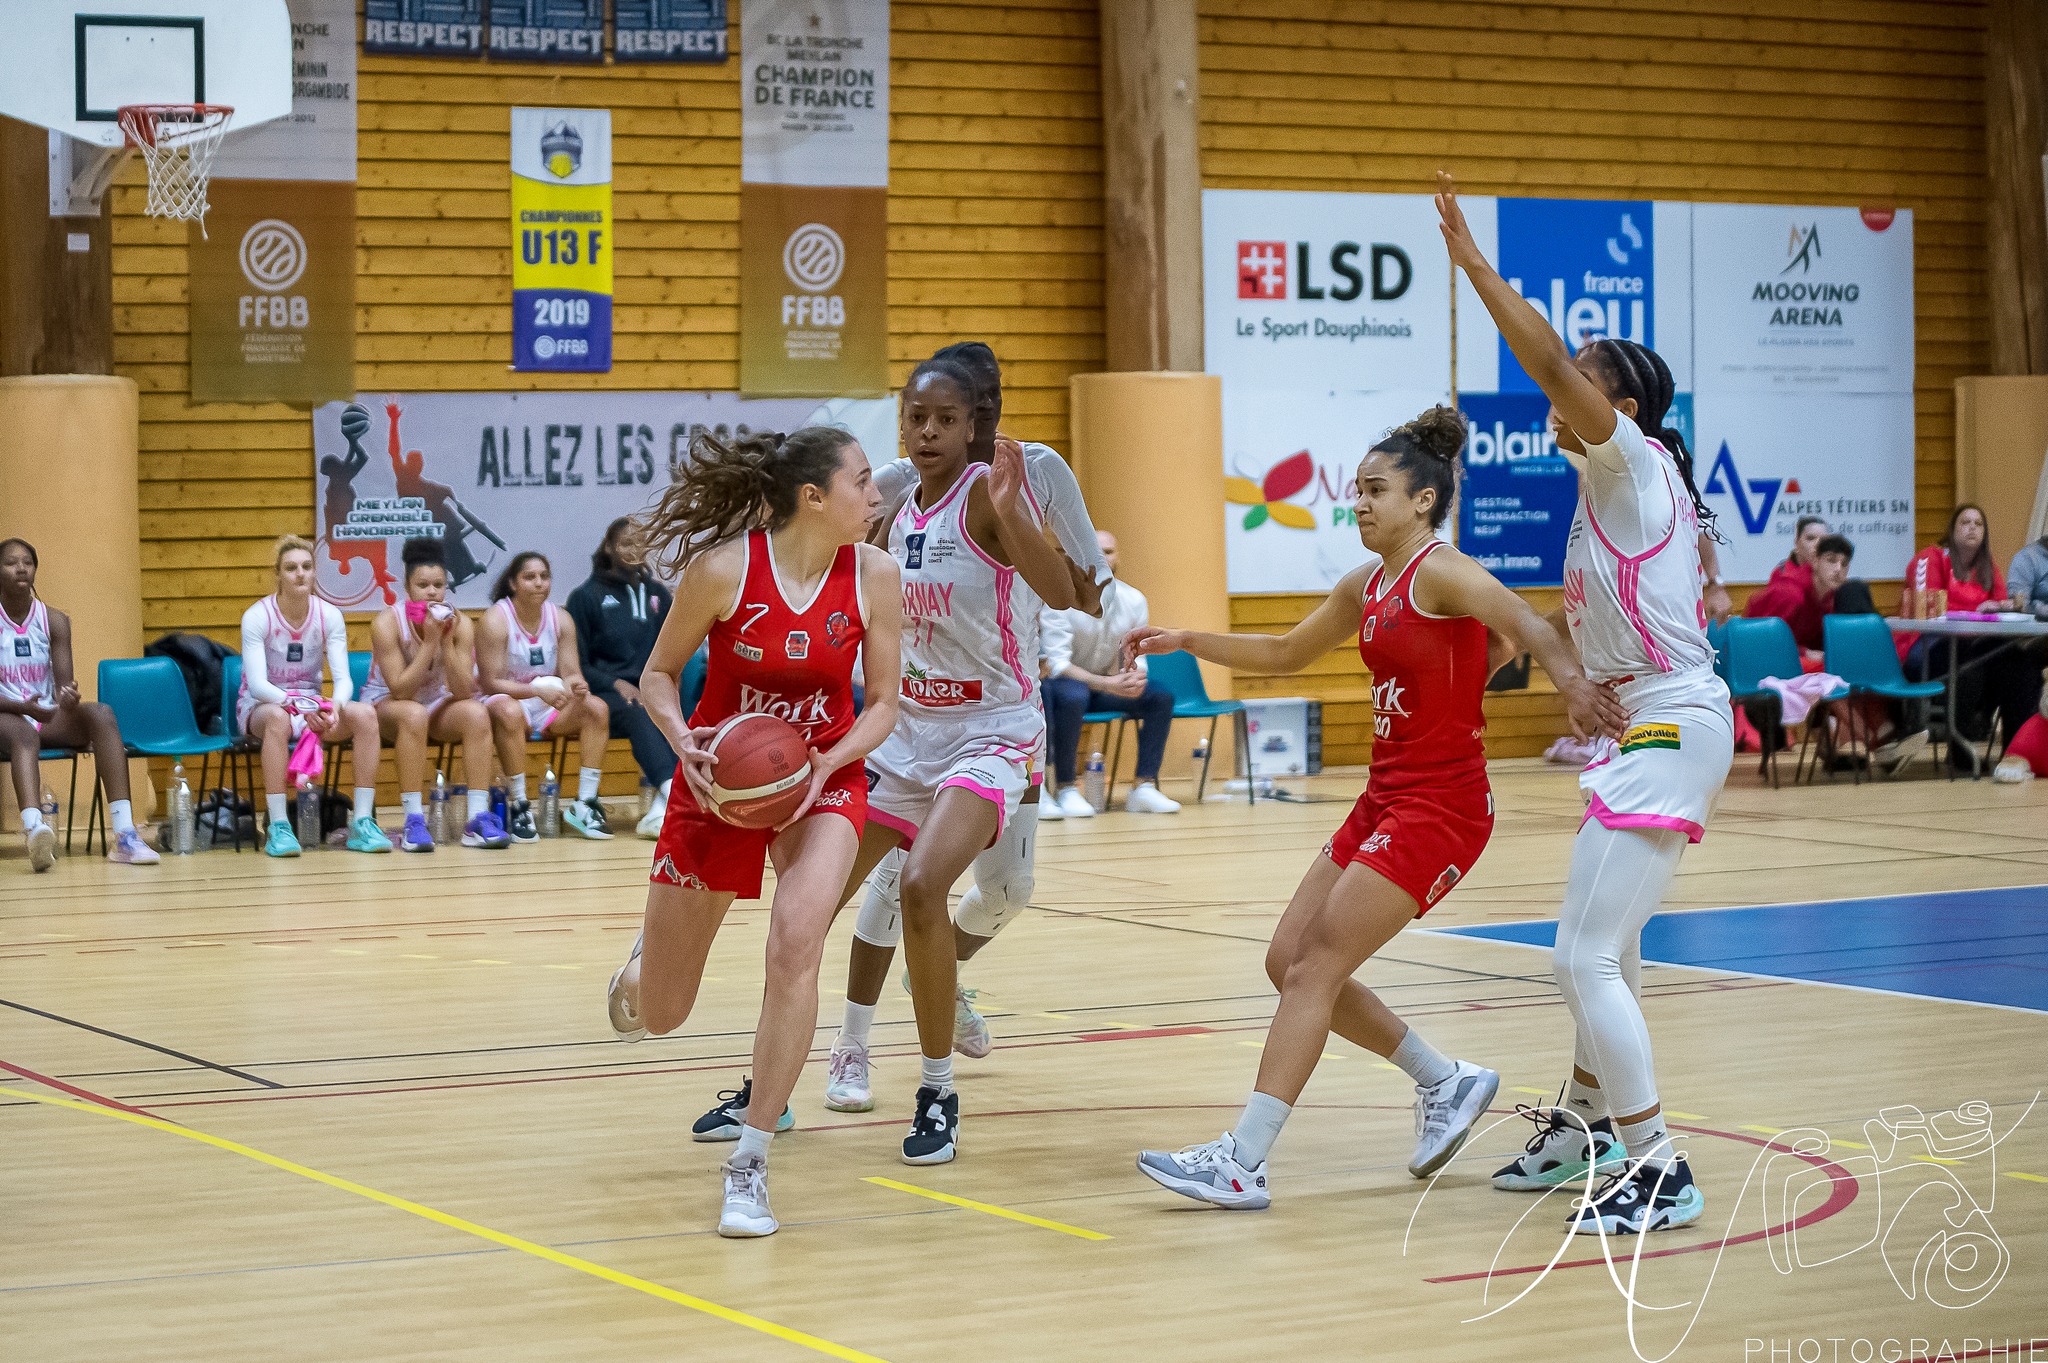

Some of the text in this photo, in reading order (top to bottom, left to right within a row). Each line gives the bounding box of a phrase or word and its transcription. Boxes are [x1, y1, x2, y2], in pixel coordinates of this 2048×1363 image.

[366, 19, 483, 49] RESPECT
[490, 26, 605, 53] RESPECT
[617, 28, 728, 53] RESPECT
[755, 64, 874, 87] CHAMPION
[755, 85, 875, 109] DE FRANCE
[521, 210, 603, 223] CHAMPIONNES
[522, 229, 603, 265] U13 F
[1297, 240, 1413, 302] LSD
[1583, 270, 1644, 294] france
[1752, 281, 1860, 302] MOOVING
[239, 295, 310, 328] FFBB
[534, 298, 590, 326] 2019
[782, 295, 846, 326] FFBB
[1769, 306, 1844, 326] ARENA
[1237, 315, 1412, 342] Le Sport Dauphinois
[556, 339, 589, 357] FFBB
[477, 424, 583, 487] ALLEZ
[596, 423, 655, 485] LES
[356, 499, 423, 511] MEYLAN
[1474, 497, 1521, 508] GESTION
[1777, 500, 1822, 514] ALPES
[349, 512, 430, 523] GRENOBLE
[1333, 506, 1358, 527] PR
[1474, 511, 1550, 521] TRANSACTION
[1858, 521, 1909, 535] coffrage
[335, 525, 445, 537] HANDIBASKET
[1474, 525, 1502, 536] NEUF
[901, 581, 955, 617] RNAY
[740, 603, 770, 635] 7
[740, 683, 832, 724] Work
[1370, 676, 1409, 719] ork
